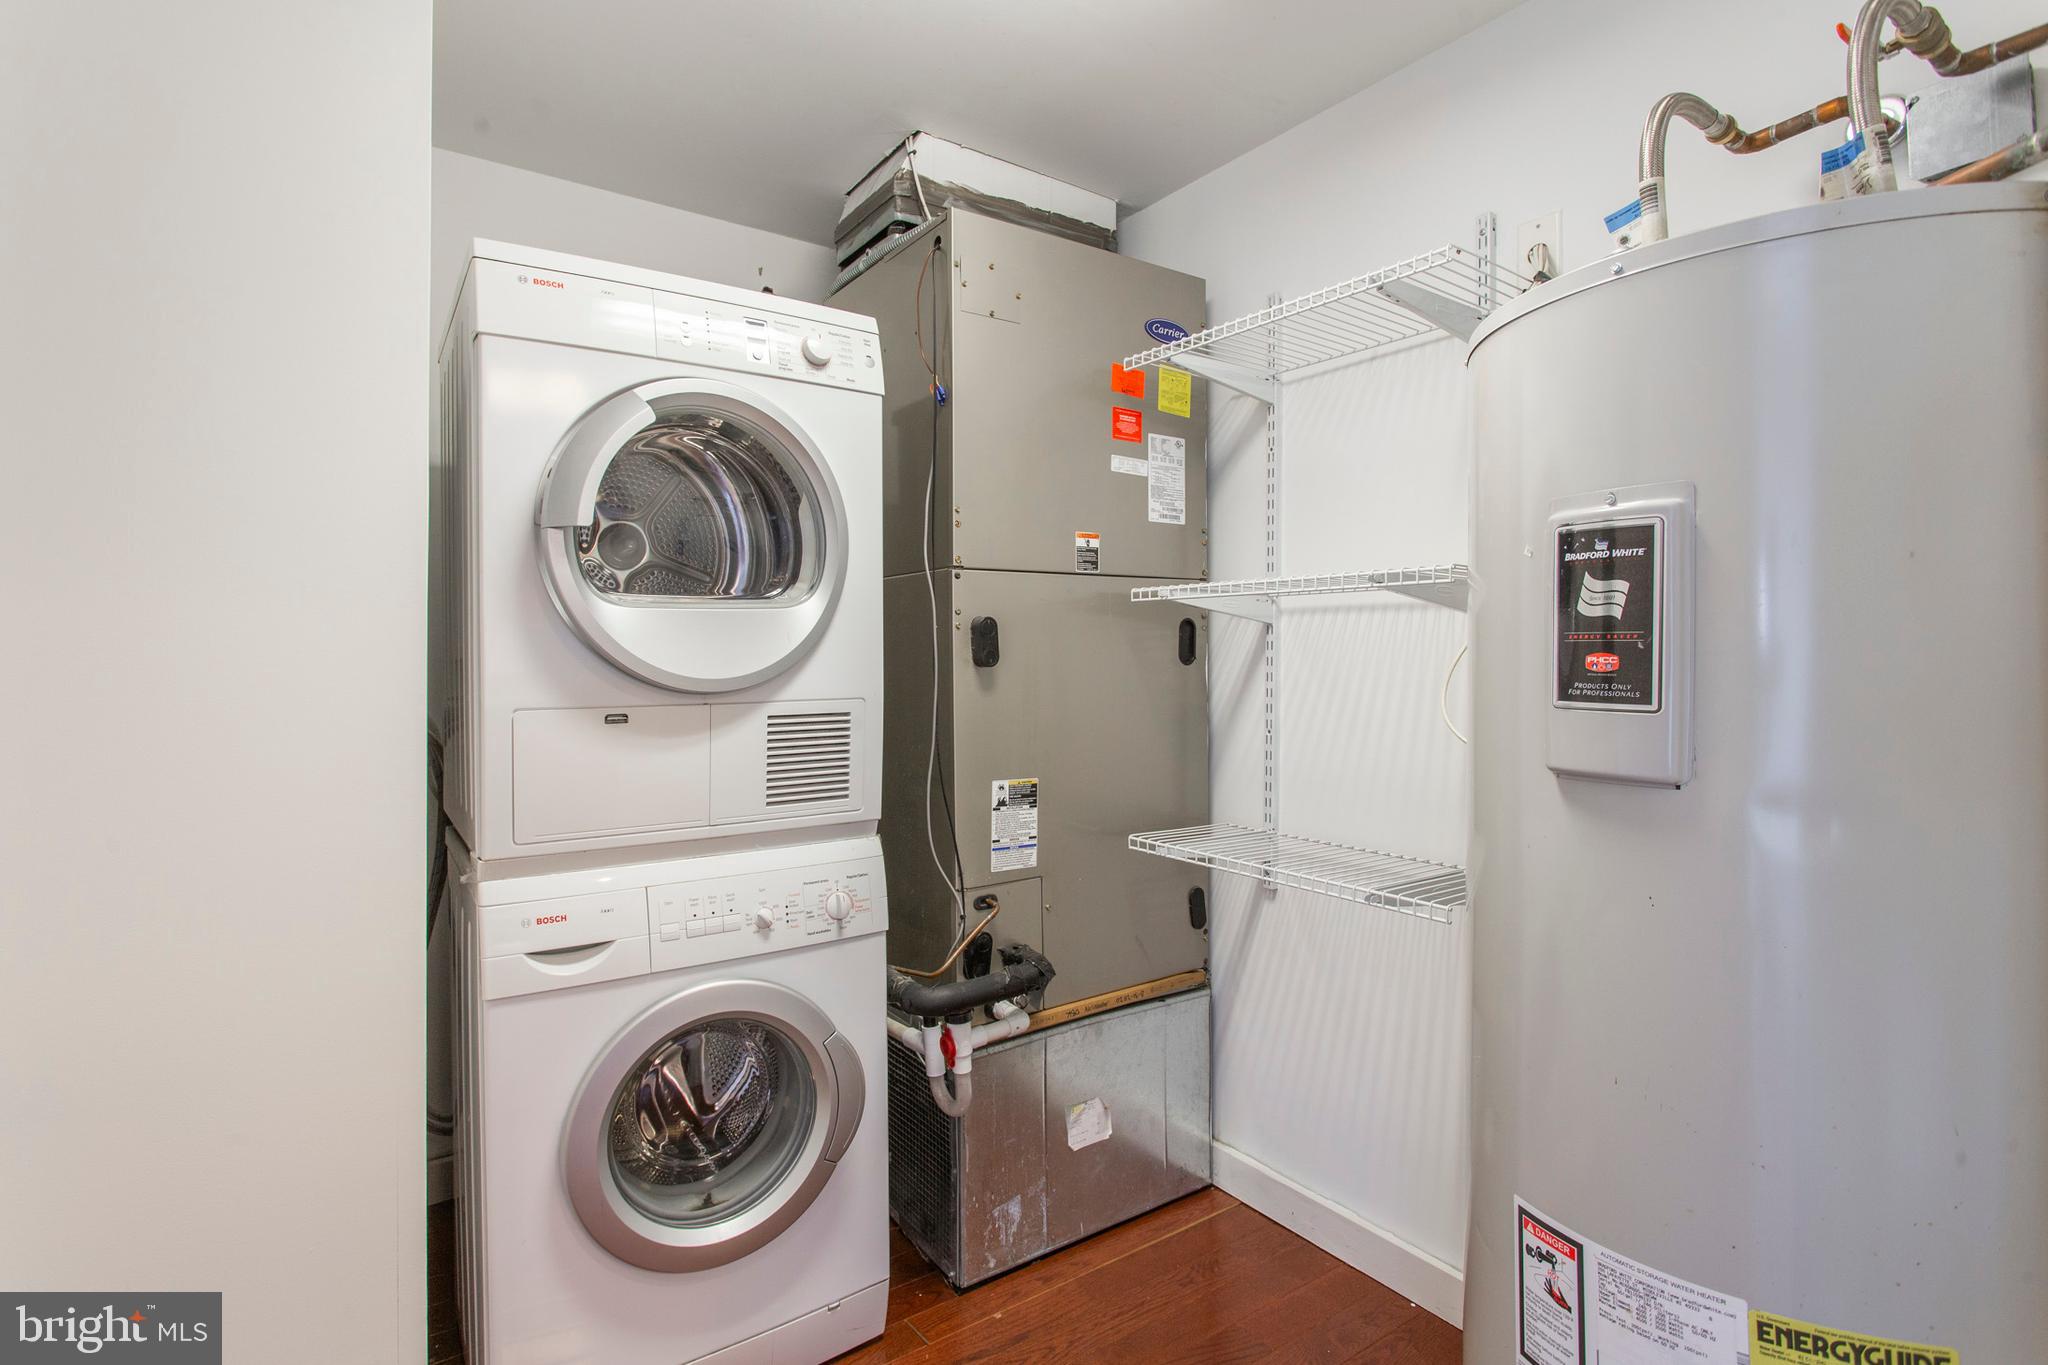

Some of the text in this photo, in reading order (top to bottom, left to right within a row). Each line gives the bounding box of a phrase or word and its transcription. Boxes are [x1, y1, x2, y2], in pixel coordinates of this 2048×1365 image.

[533, 278, 564, 289] BOSCH
[1152, 323, 1184, 339] Carrier
[1564, 548, 1645, 561] BRADFORD WHITE
[1574, 681, 1609, 690] PRODUCTS
[1582, 689, 1640, 698] PROFESSIONALS
[536, 914, 567, 925] BOSCH
[1535, 1227, 1571, 1256] DANGER
[1600, 1251, 1636, 1272] AUTOMATIC
[1636, 1267, 1669, 1286] STORAGE
[1671, 1282, 1696, 1296] WATER
[1696, 1291, 1727, 1306] HEATER
